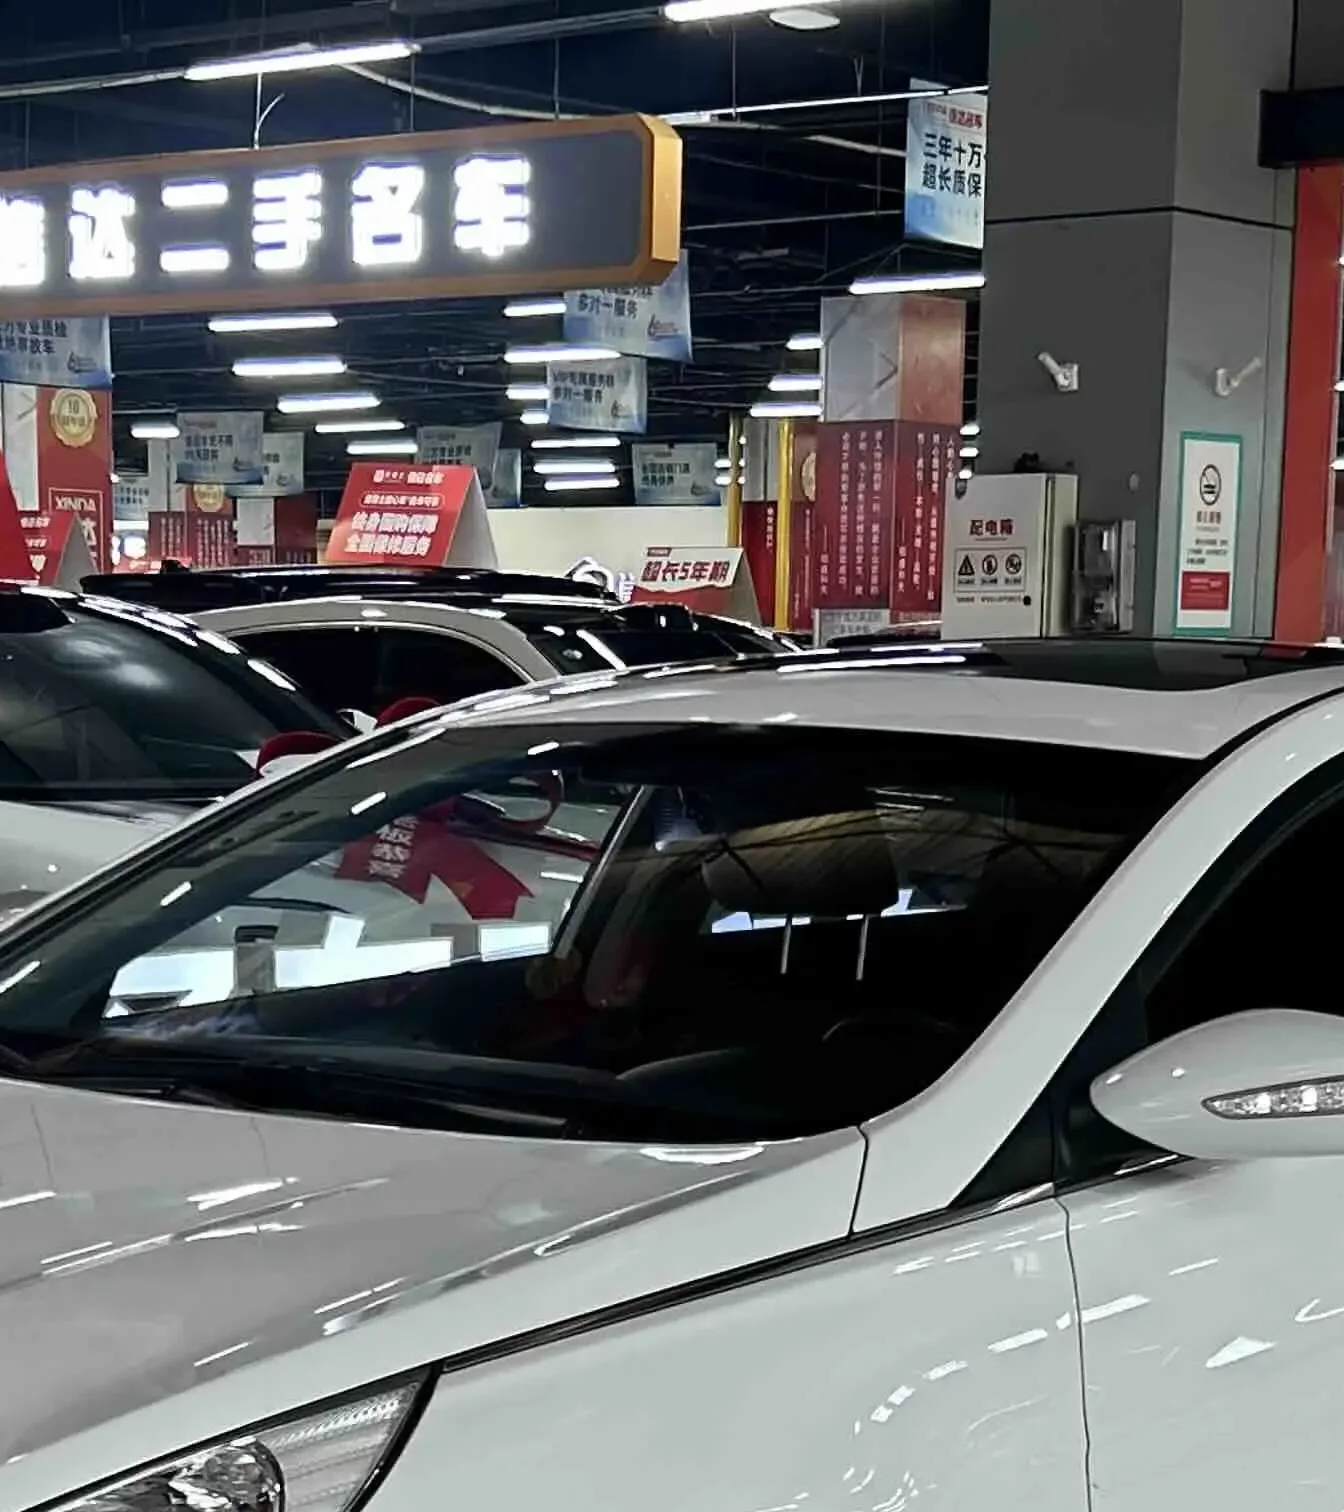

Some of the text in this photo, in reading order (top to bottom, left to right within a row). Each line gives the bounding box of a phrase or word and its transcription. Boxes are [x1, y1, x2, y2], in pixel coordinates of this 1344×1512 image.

[923, 132, 987, 169] 三年十万
[922, 162, 983, 198] 超长质保
